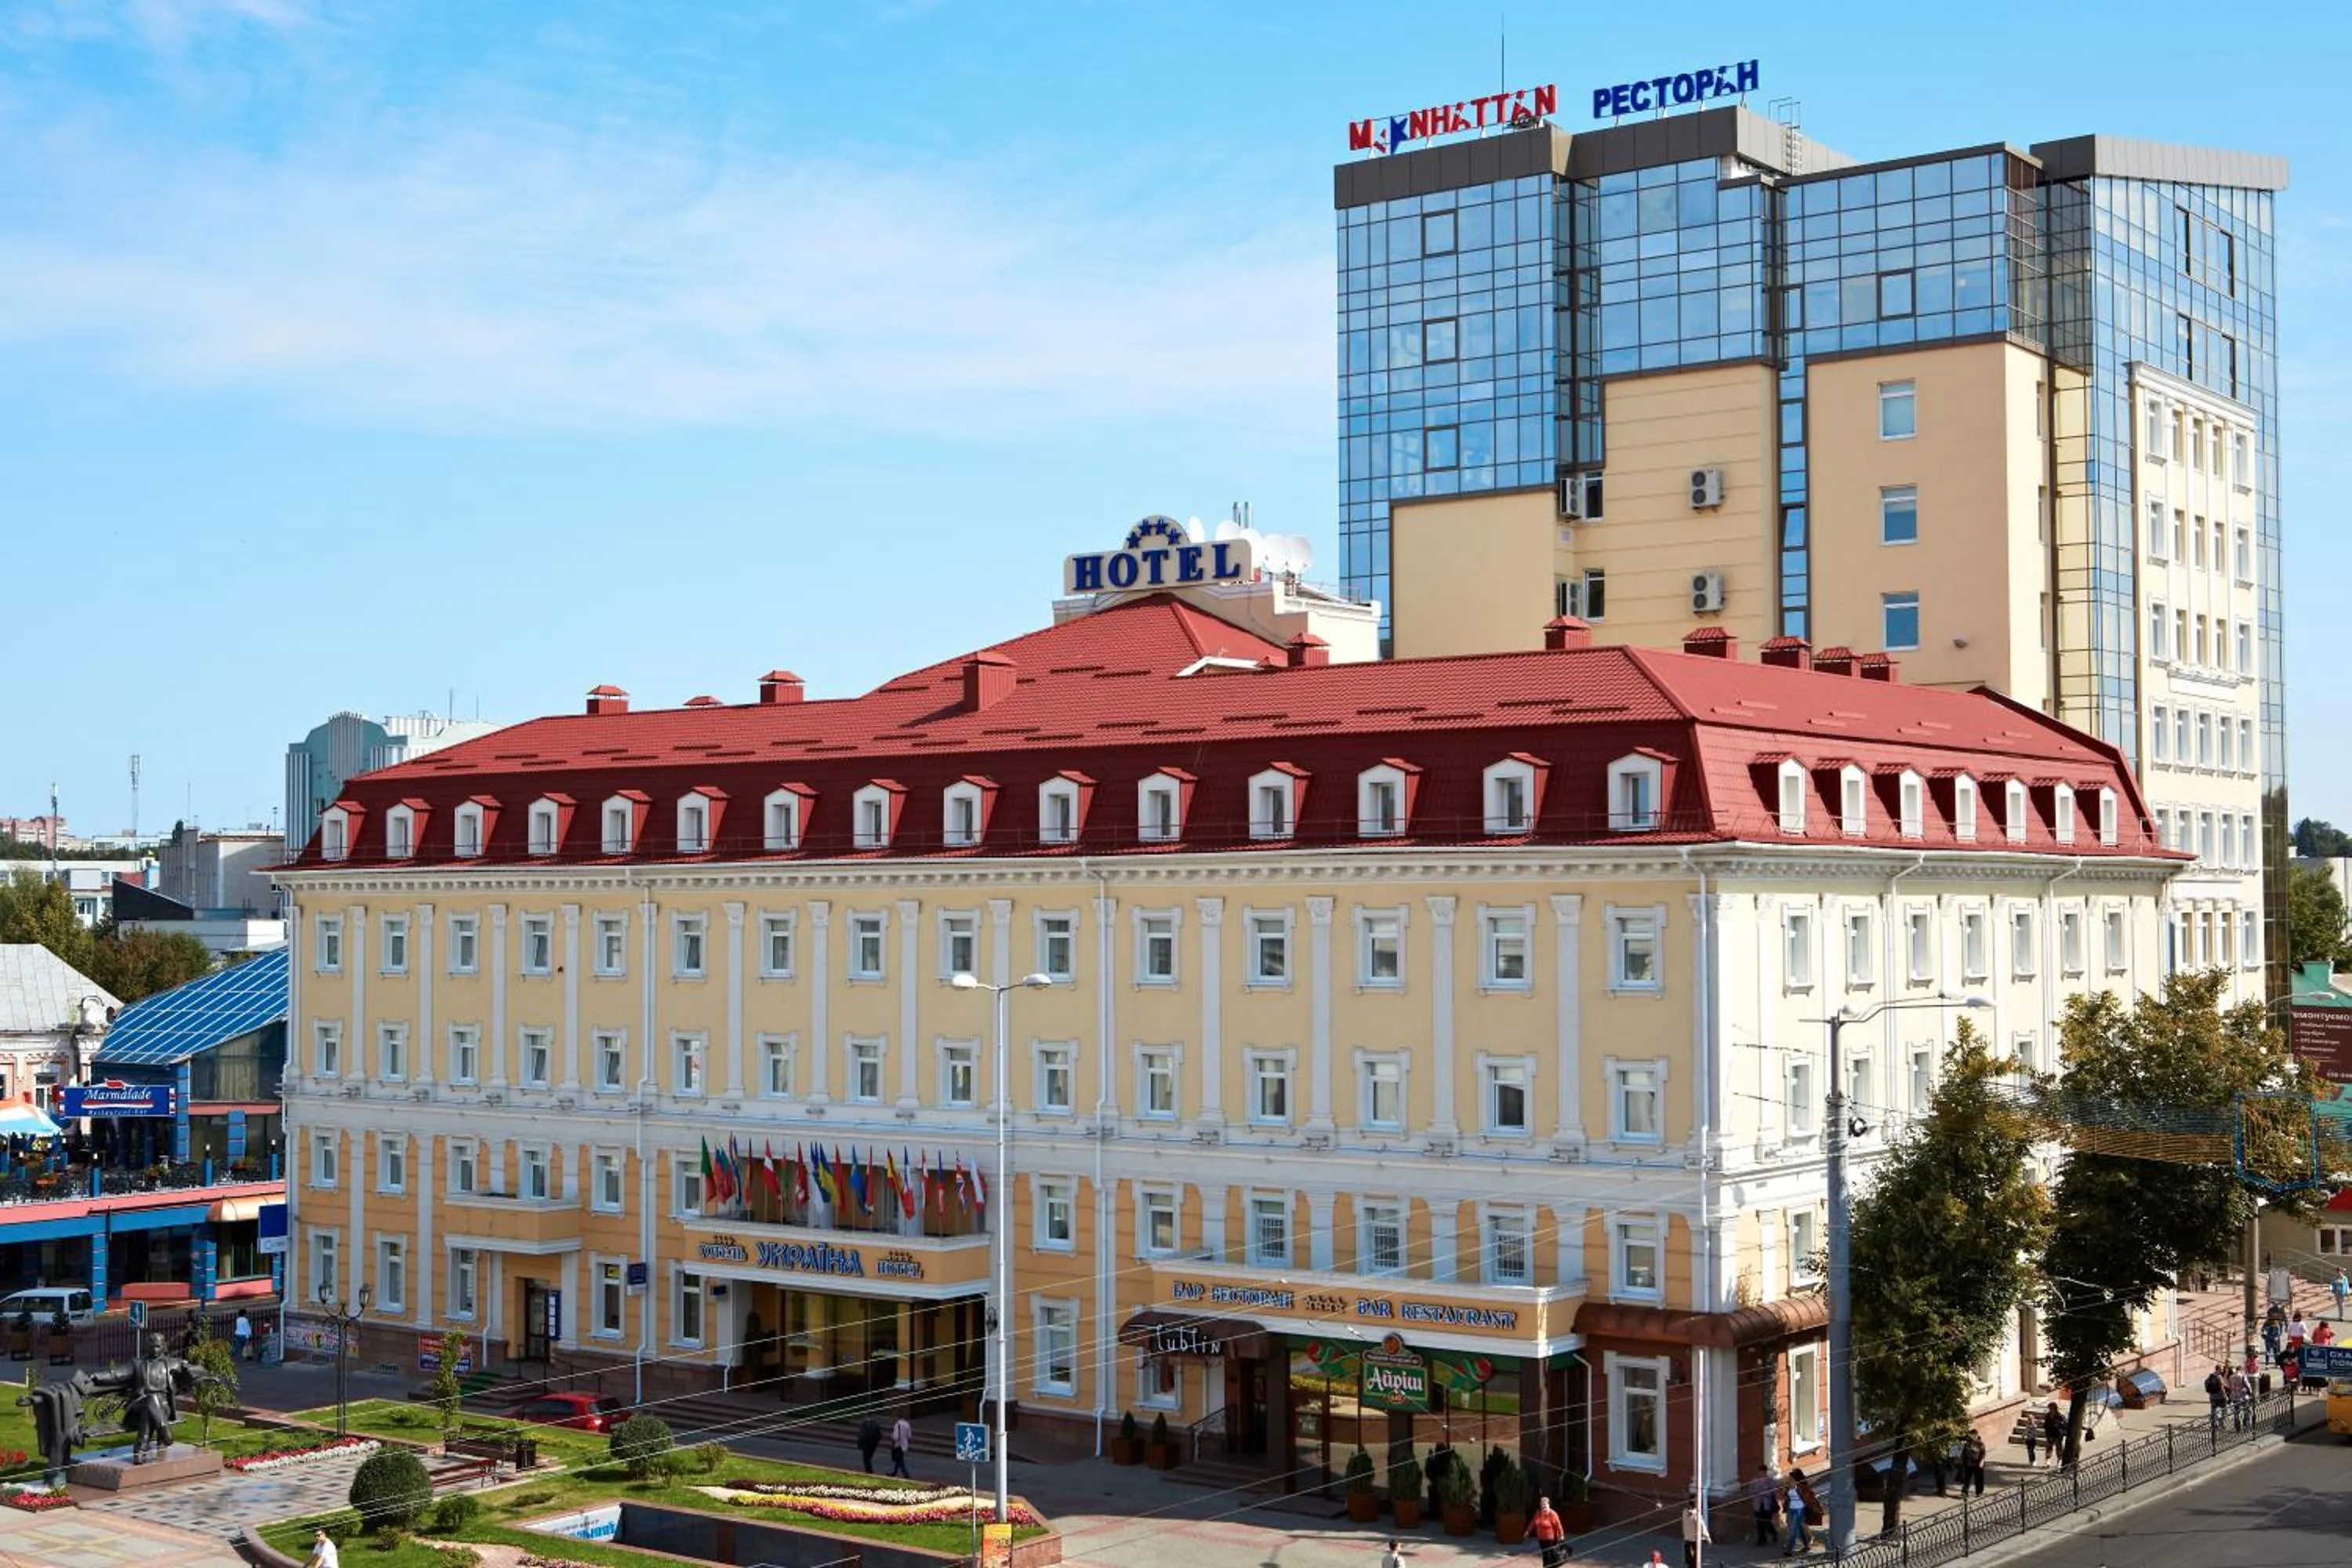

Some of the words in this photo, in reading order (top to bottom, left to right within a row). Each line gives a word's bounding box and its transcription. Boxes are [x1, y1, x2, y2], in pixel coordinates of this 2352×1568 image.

[1593, 59, 1759, 118] РЕСТОРАН
[1073, 543, 1241, 590] HOTEL
[84, 1087, 151, 1100] Marmalade
[757, 1242, 864, 1277] УКРАЇНА
[1356, 1298, 1393, 1318] BAR
[1400, 1303, 1517, 1330] RESTAURANT
